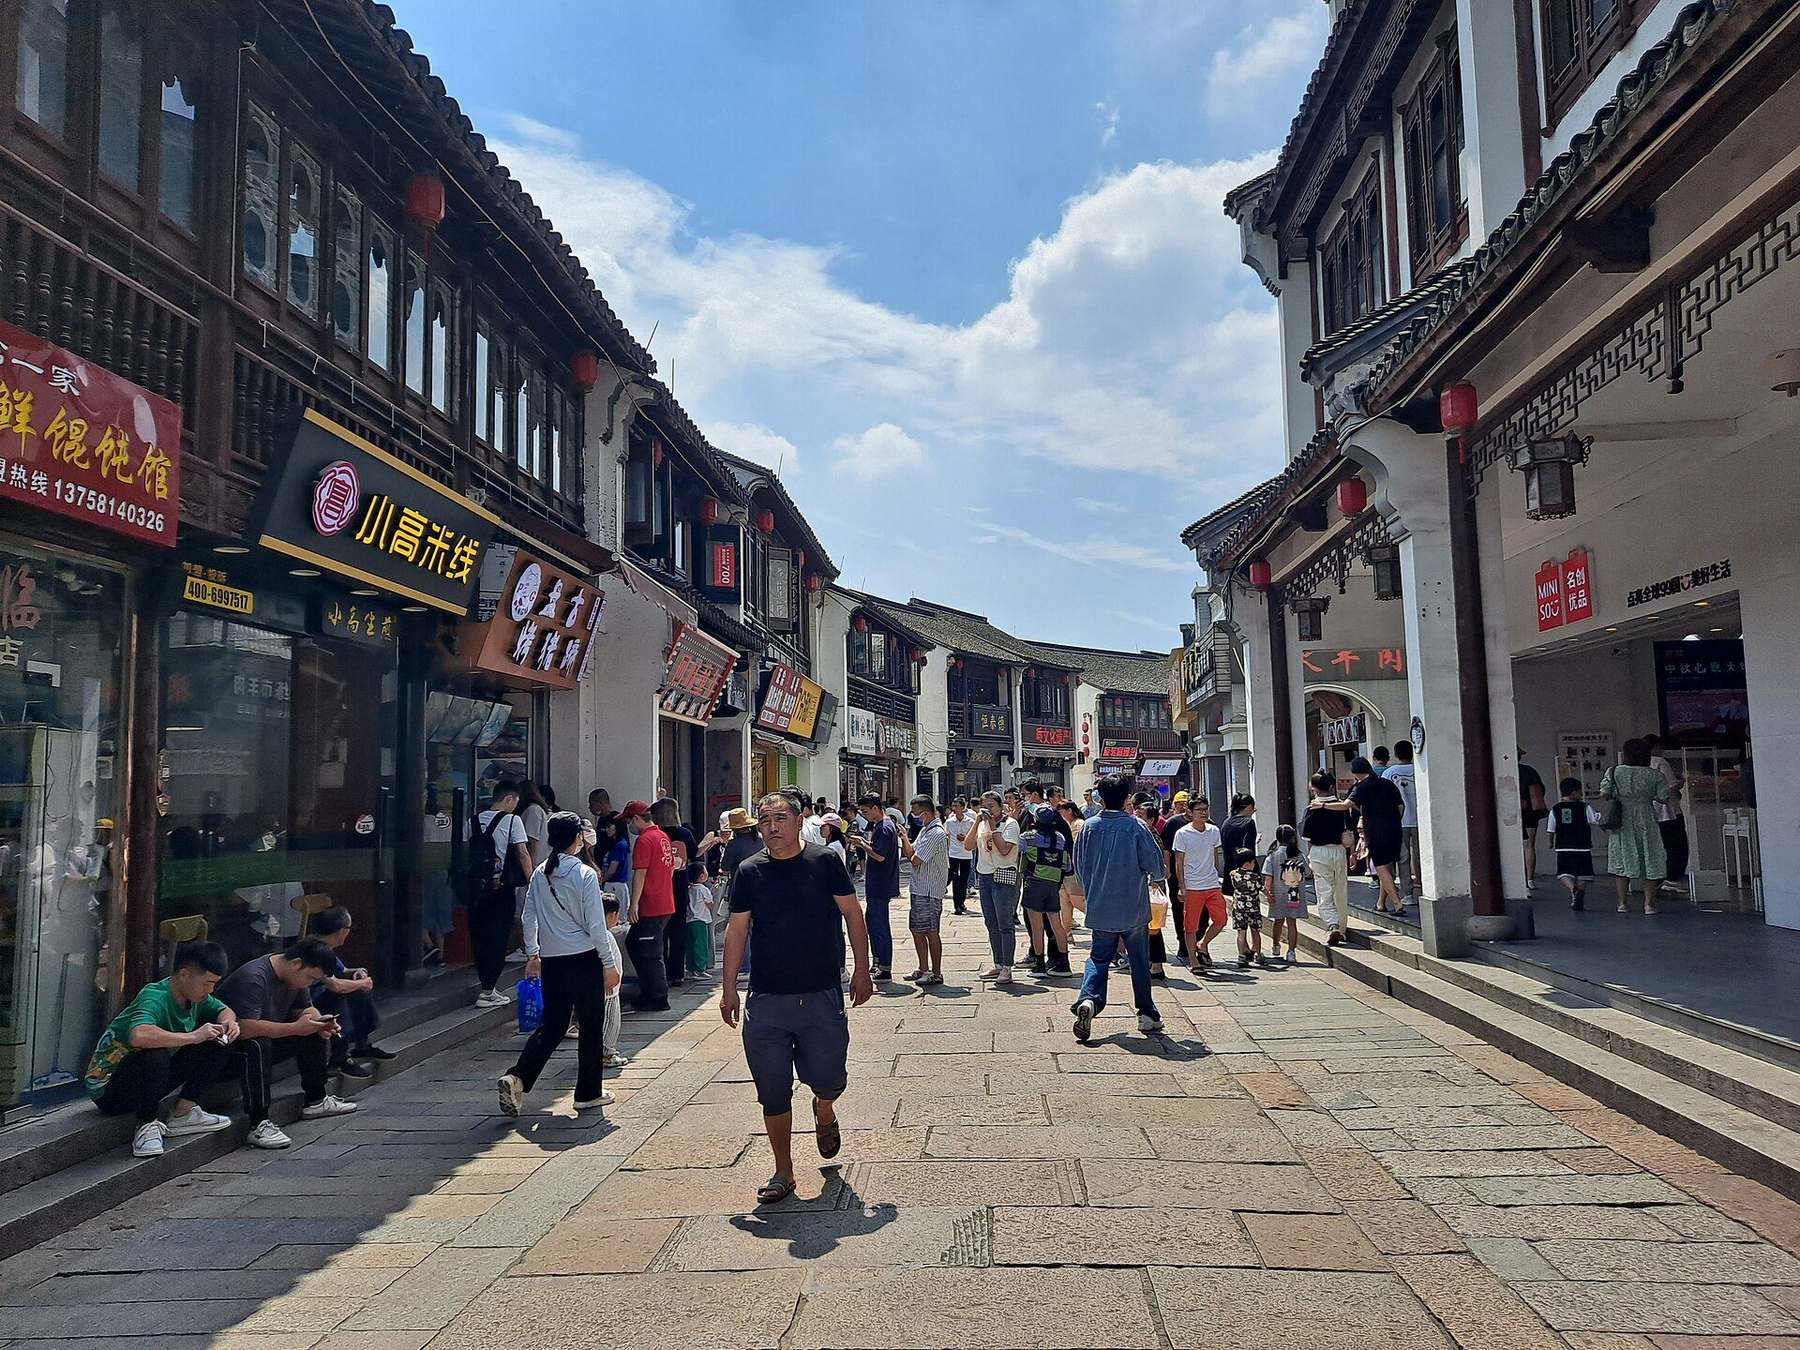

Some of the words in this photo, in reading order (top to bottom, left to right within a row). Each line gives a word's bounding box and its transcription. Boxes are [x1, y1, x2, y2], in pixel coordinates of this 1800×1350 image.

[0, 341, 80, 396] 一家
[0, 380, 173, 500] 鲜馄饨馆
[0, 457, 49, 497] 热线
[54, 478, 165, 533] 13758140326
[355, 495, 480, 585] 小高米线
[187, 578, 250, 609] 400-6997517
[1538, 578, 1558, 600] MINI
[1566, 566, 1586, 589] 名创
[1568, 589, 1588, 611] 优品
[326, 602, 394, 642] 小高生煎
